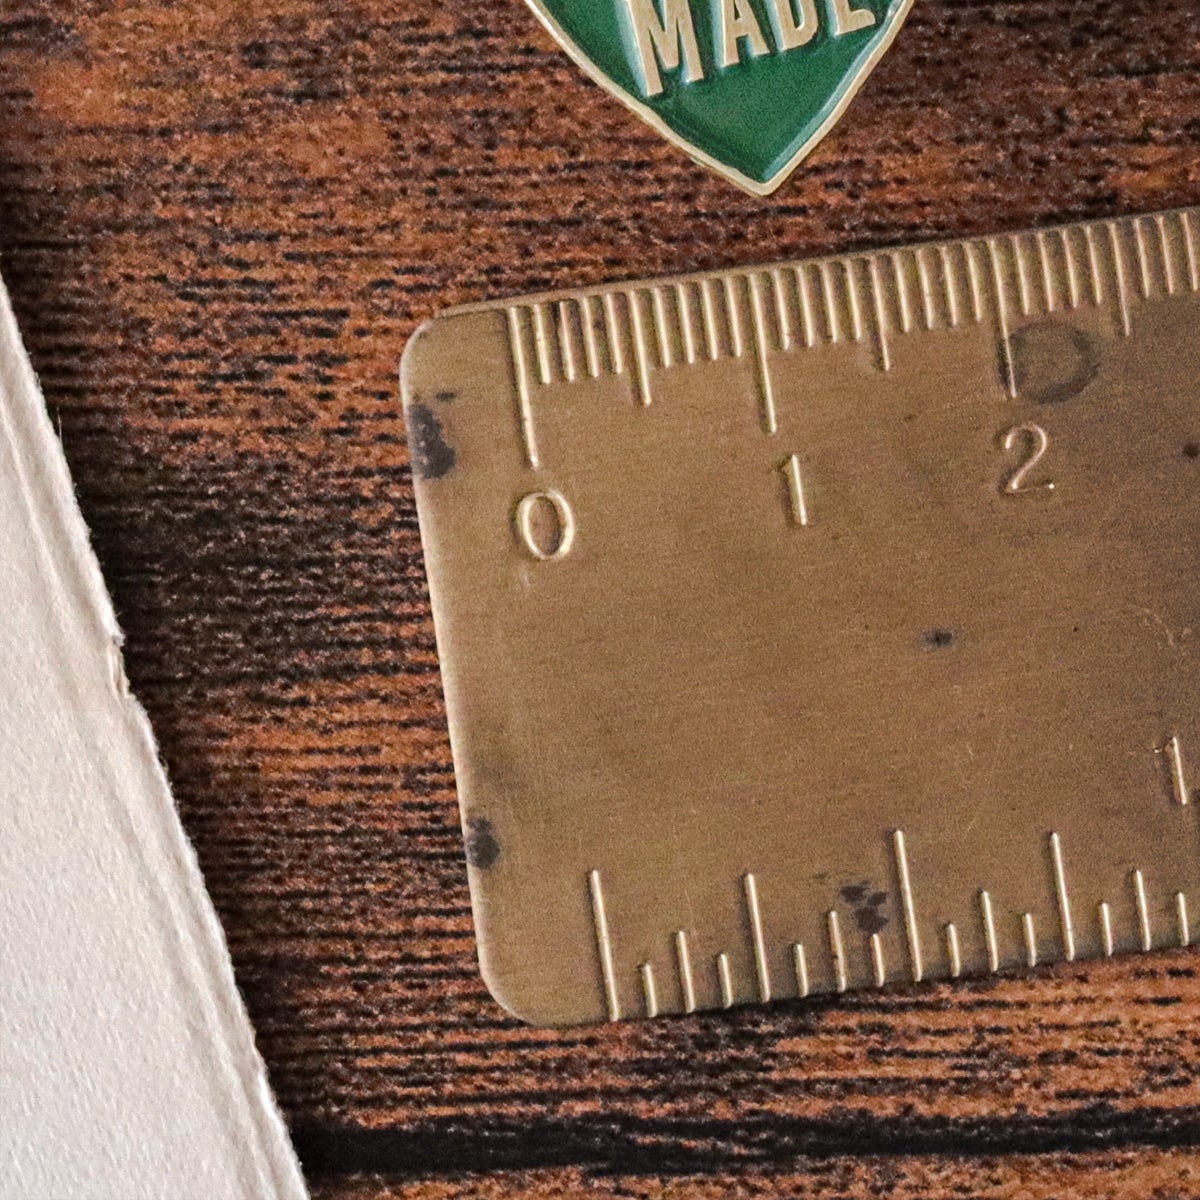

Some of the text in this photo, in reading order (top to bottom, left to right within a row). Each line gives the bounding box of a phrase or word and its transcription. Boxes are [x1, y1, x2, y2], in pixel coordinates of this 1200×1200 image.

[515, 489, 575, 560] 0
[780, 453, 808, 527] 1
[1003, 422, 1055, 493] 2
[1154, 735, 1188, 806] 1
